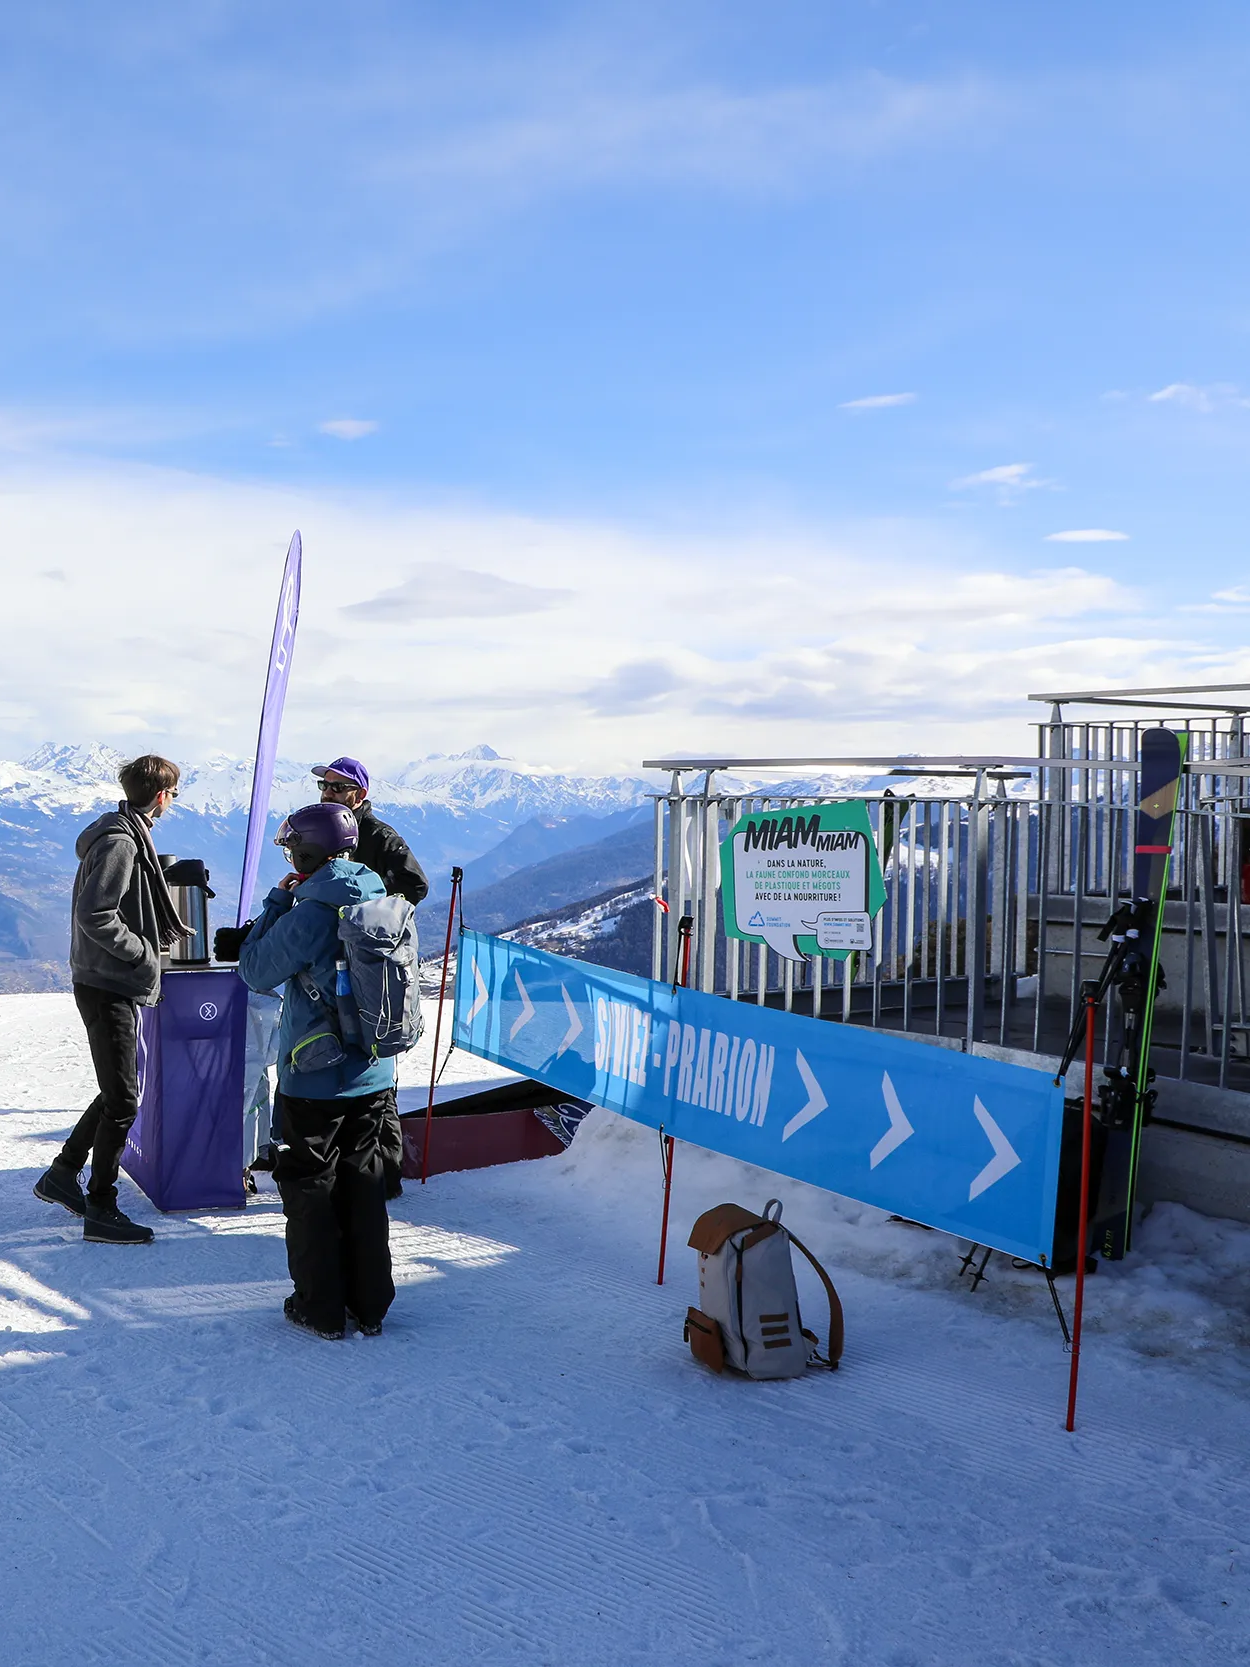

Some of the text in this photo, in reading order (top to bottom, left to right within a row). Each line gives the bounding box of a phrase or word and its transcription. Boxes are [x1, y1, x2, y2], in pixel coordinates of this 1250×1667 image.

[744, 814, 860, 853] MIAM MIAM
[767, 859, 827, 869] DANS LA NATURE,
[746, 870, 850, 879] LA FAUNE CONFOND MORCEAUX
[755, 880, 841, 891] DE PLASTIQUE ET MÉGOTS
[755, 892, 772, 901] AVEC
[773, 892, 782, 901] DE
[783, 892, 792, 901] LA
[663, 1019, 775, 1127] PRARION
